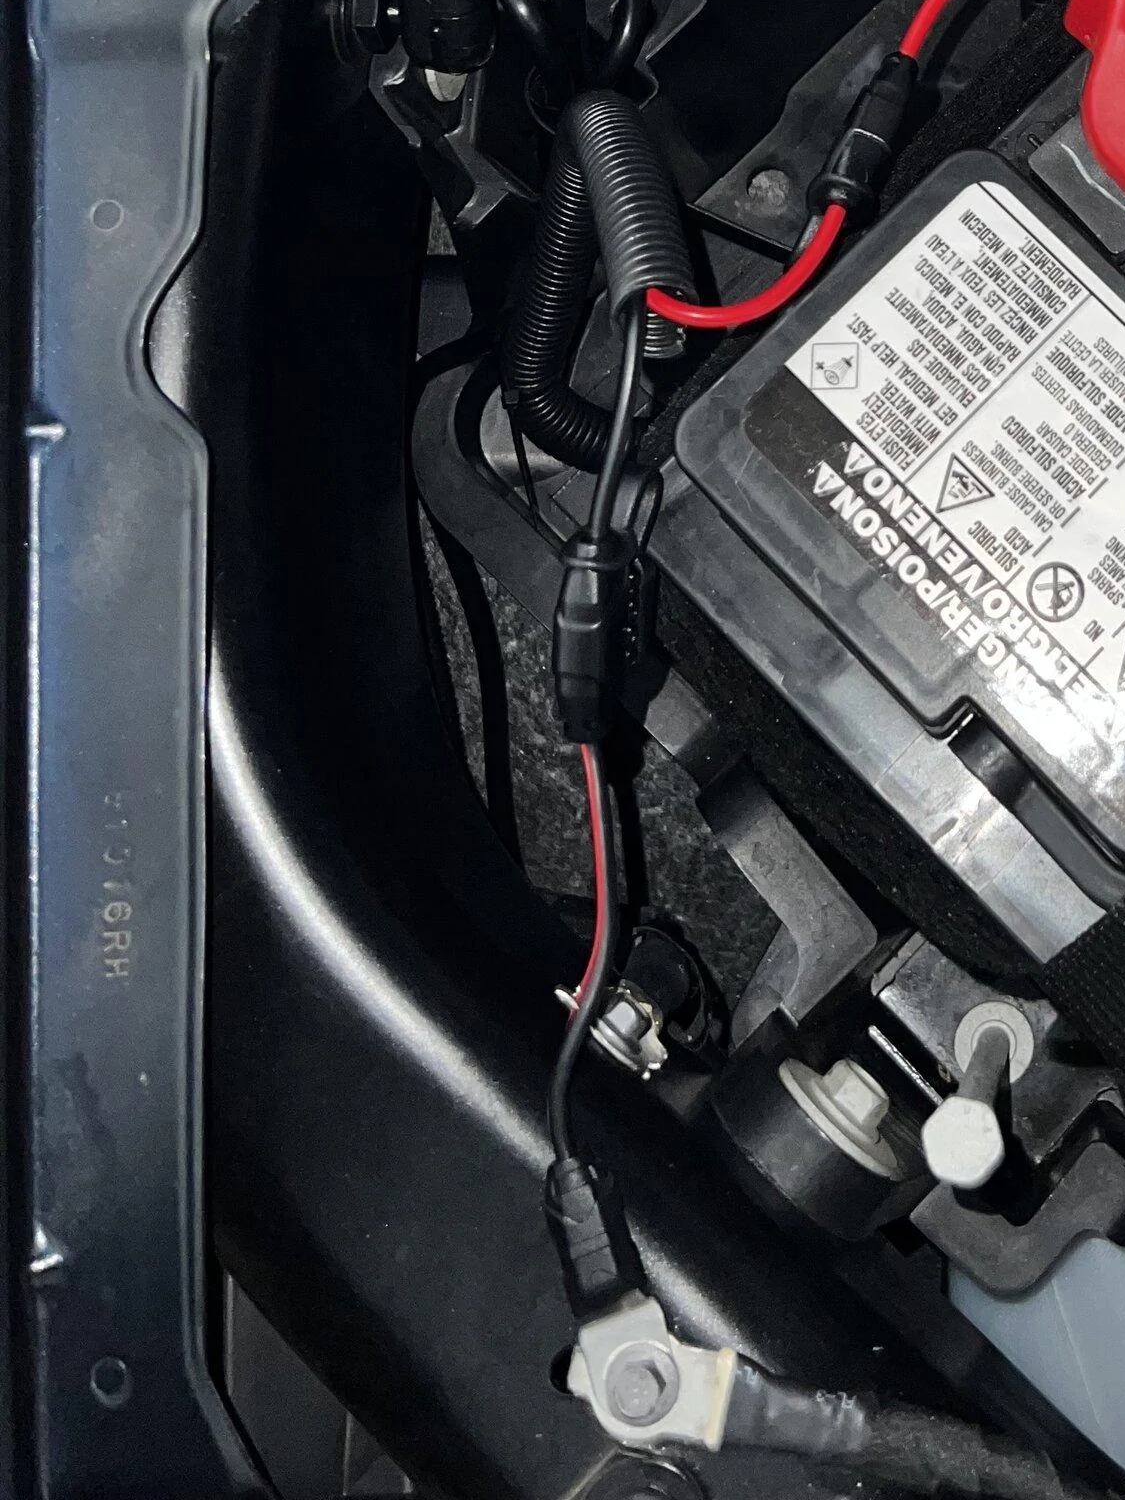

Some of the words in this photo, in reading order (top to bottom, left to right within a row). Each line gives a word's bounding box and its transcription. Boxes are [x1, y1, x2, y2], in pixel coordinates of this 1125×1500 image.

[846, 316, 876, 345] FAST.
[870, 341, 900, 368] HELP
[879, 378, 916, 420] WATER.
[894, 360, 940, 408] MEDICAL
[856, 411, 886, 442] EYES
[861, 391, 928, 458] IMMEDIATELY
[910, 412, 941, 444] WITH
[932, 402, 958, 426] GET
[878, 434, 915, 471] FLUSH
[961, 440, 1010, 489] BLINDNESS
[990, 440, 1023, 476] BURNS.
[1003, 482, 1036, 515] CAUSE
[1017, 470, 1053, 507] SEVERE
[1030, 509, 1053, 533] CAN
[1048, 500, 1066, 519] OR
[967, 520, 1018, 572] SULFURIC
[1003, 526, 1033, 555] ACID
[1087, 566, 1124, 605] SPARKS
[1083, 619, 1104, 642] NO
